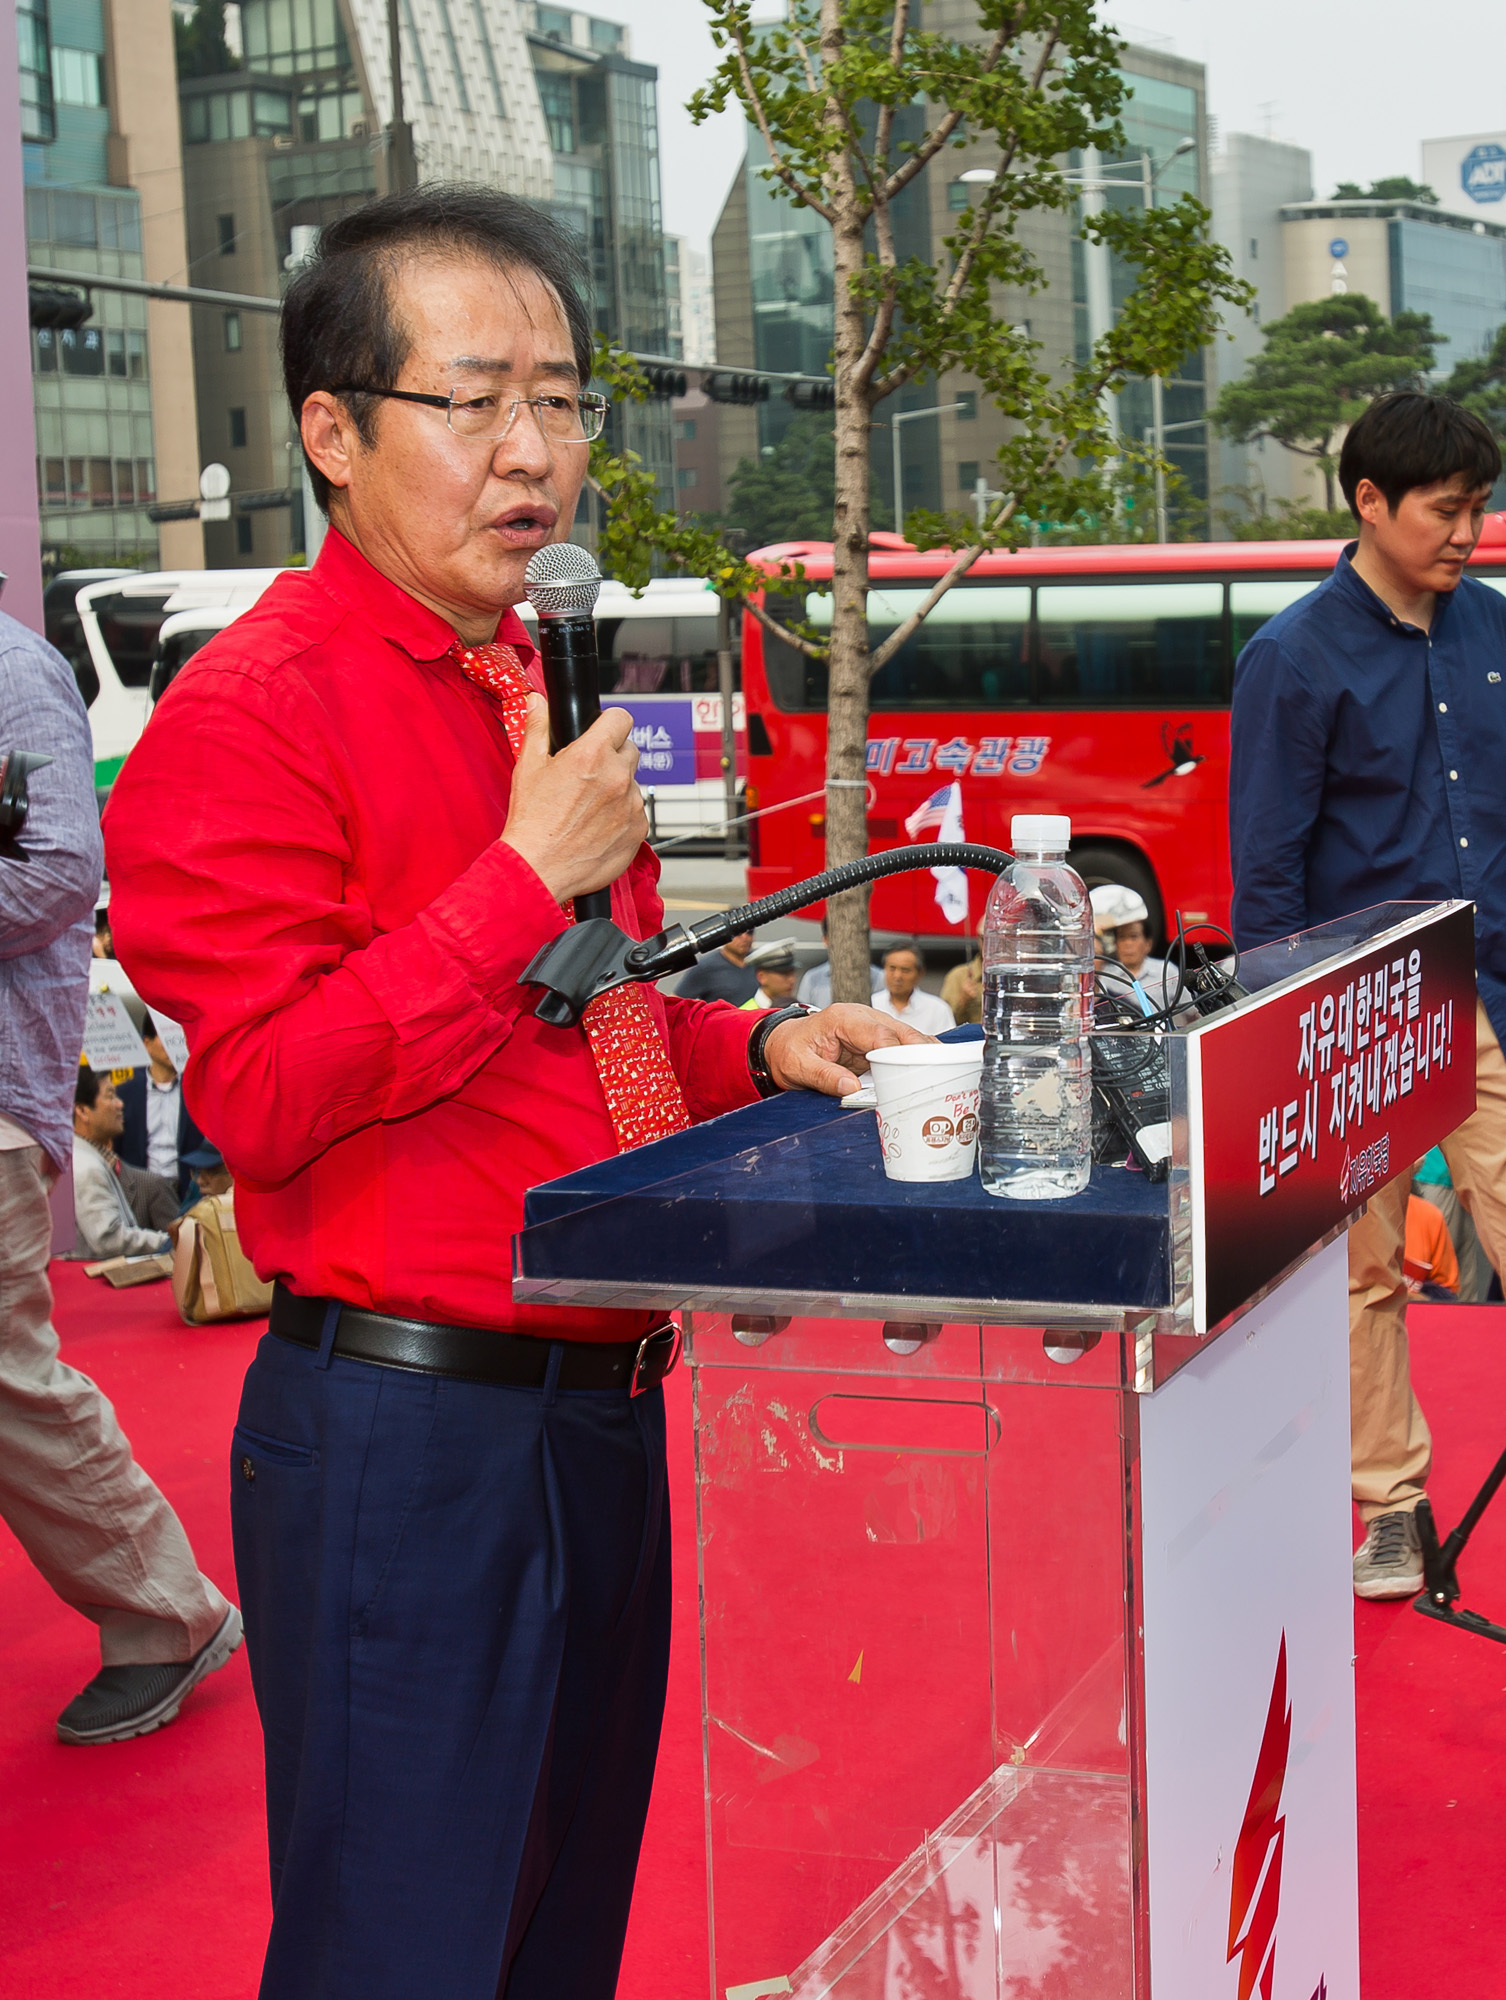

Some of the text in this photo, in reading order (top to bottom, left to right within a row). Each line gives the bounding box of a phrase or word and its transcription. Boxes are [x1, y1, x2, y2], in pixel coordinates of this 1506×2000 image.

[628, 724, 673, 751] 버스
[866, 736, 1052, 777] 미고속관광
[1297, 949, 1422, 1080] 자유대한민국을
[953, 1103, 969, 1118] Be
[1259, 999, 1453, 1197] 반드시 지켜내겠습니다!
[1350, 1131, 1390, 1196] 자유한국당
